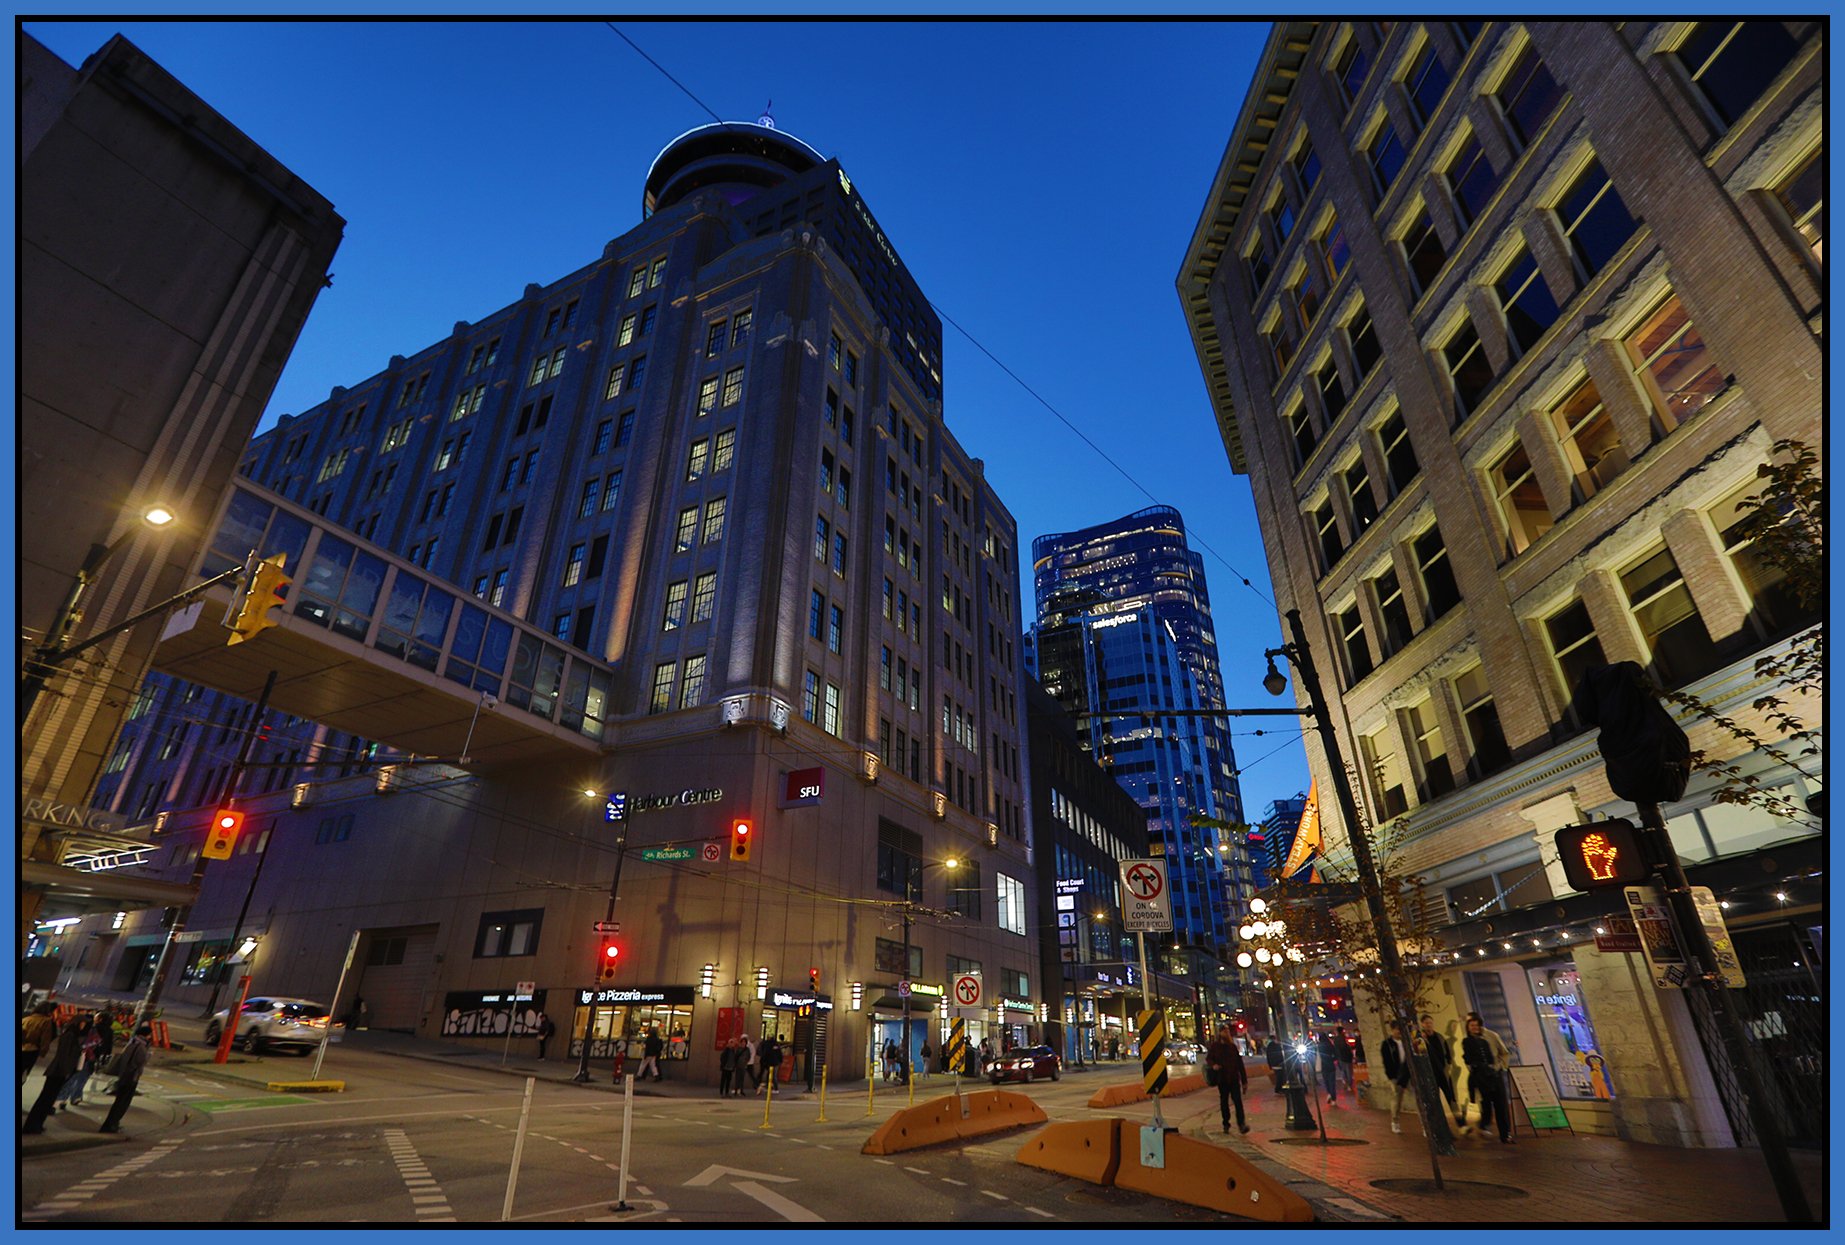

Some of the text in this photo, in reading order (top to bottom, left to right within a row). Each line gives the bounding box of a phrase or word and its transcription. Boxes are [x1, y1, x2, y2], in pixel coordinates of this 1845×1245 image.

[1092, 613, 1137, 629] salesforce
[800, 785, 820, 798] SFU
[628, 787, 723, 813] Harbour Centre
[1288, 803, 1316, 869] STEAMWORKS
[655, 850, 681, 859] Richards
[1070, 878, 1084, 886] Court
[607, 989, 641, 1001] Pizzeria
[641, 993, 664, 1001] express
